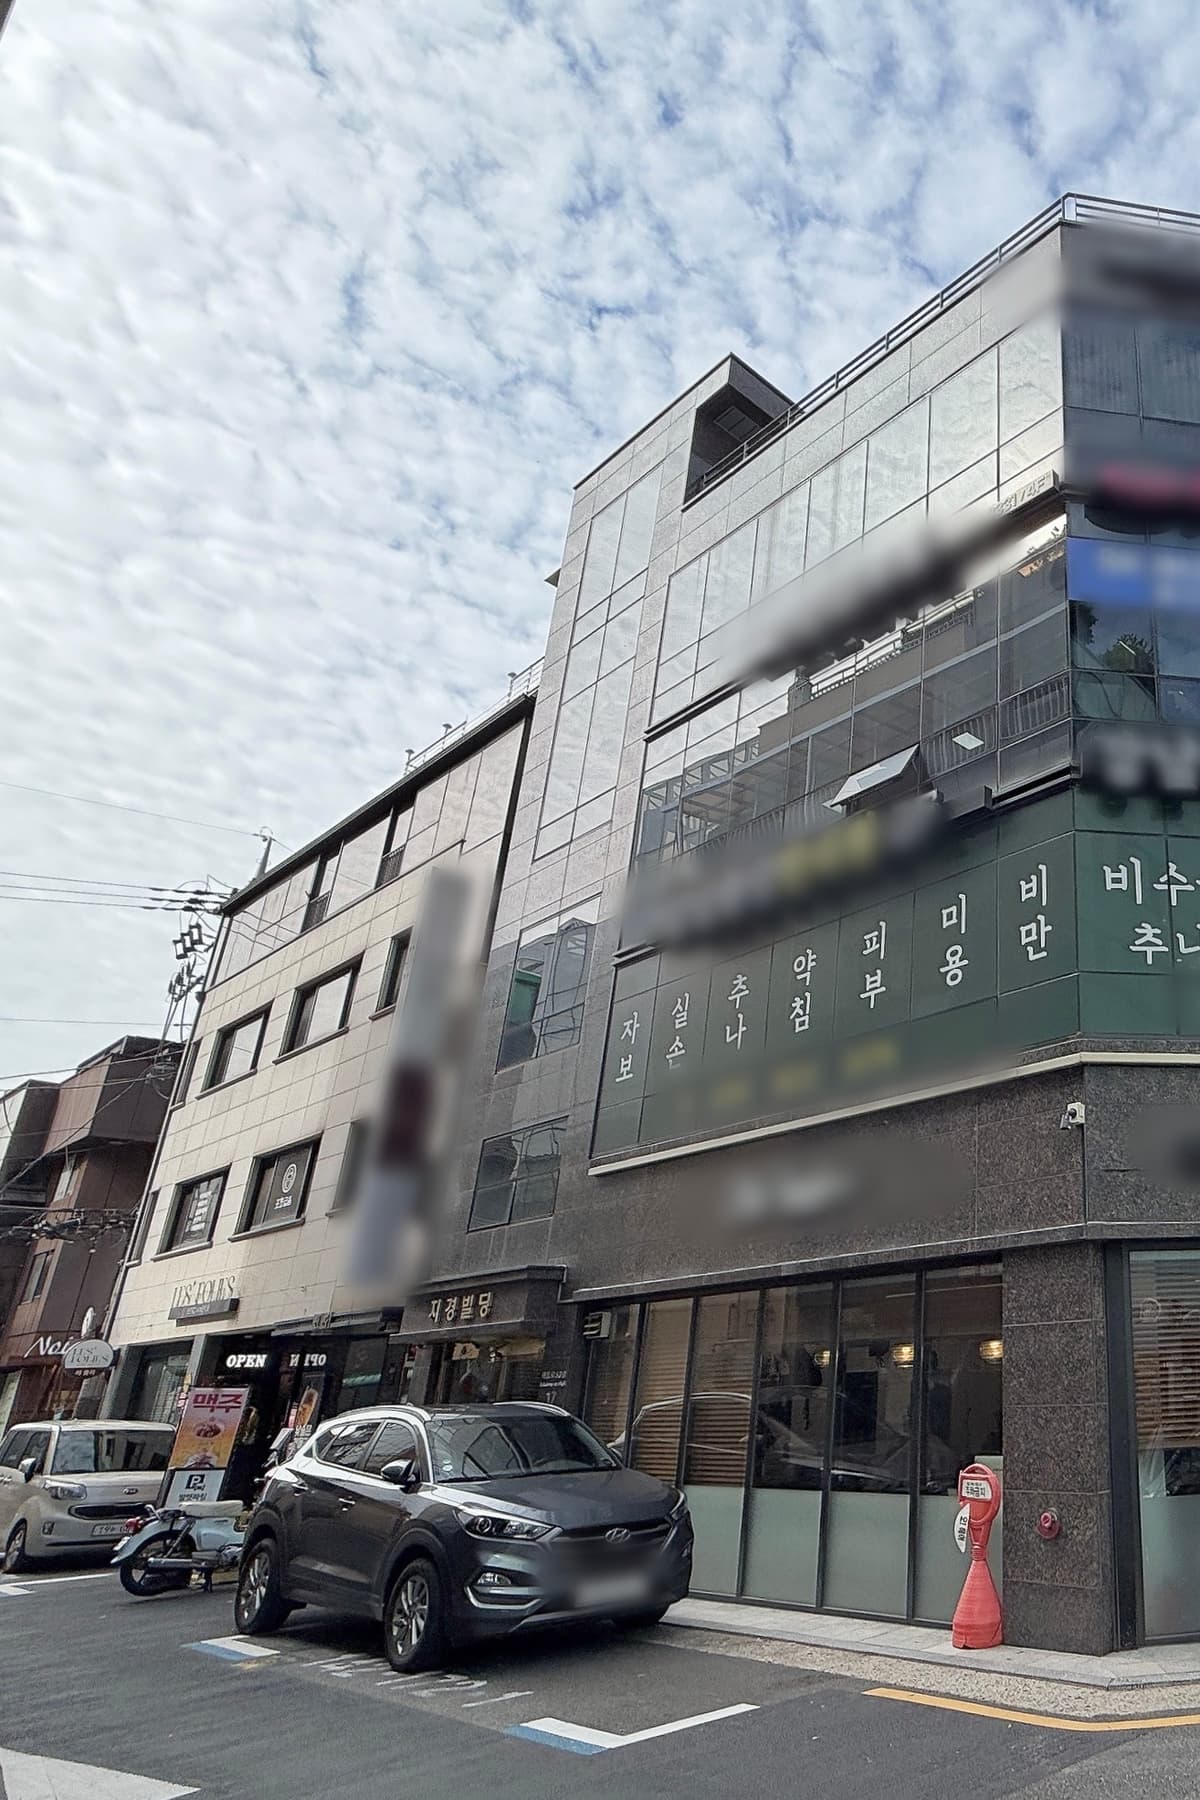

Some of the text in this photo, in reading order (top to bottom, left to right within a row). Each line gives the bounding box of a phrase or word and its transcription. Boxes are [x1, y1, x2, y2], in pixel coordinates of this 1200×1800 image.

[939, 893, 969, 986] 미용
[1019, 863, 1052, 961] 비만
[789, 948, 817, 1033] 약침
[859, 920, 887, 1009] 피부
[615, 1011, 641, 1083] 자보
[665, 992, 690, 1070] 실손
[724, 974, 750, 1050] 추나
[225, 1353, 268, 1368] OPEN
[192, 1393, 243, 1413] 맥주
